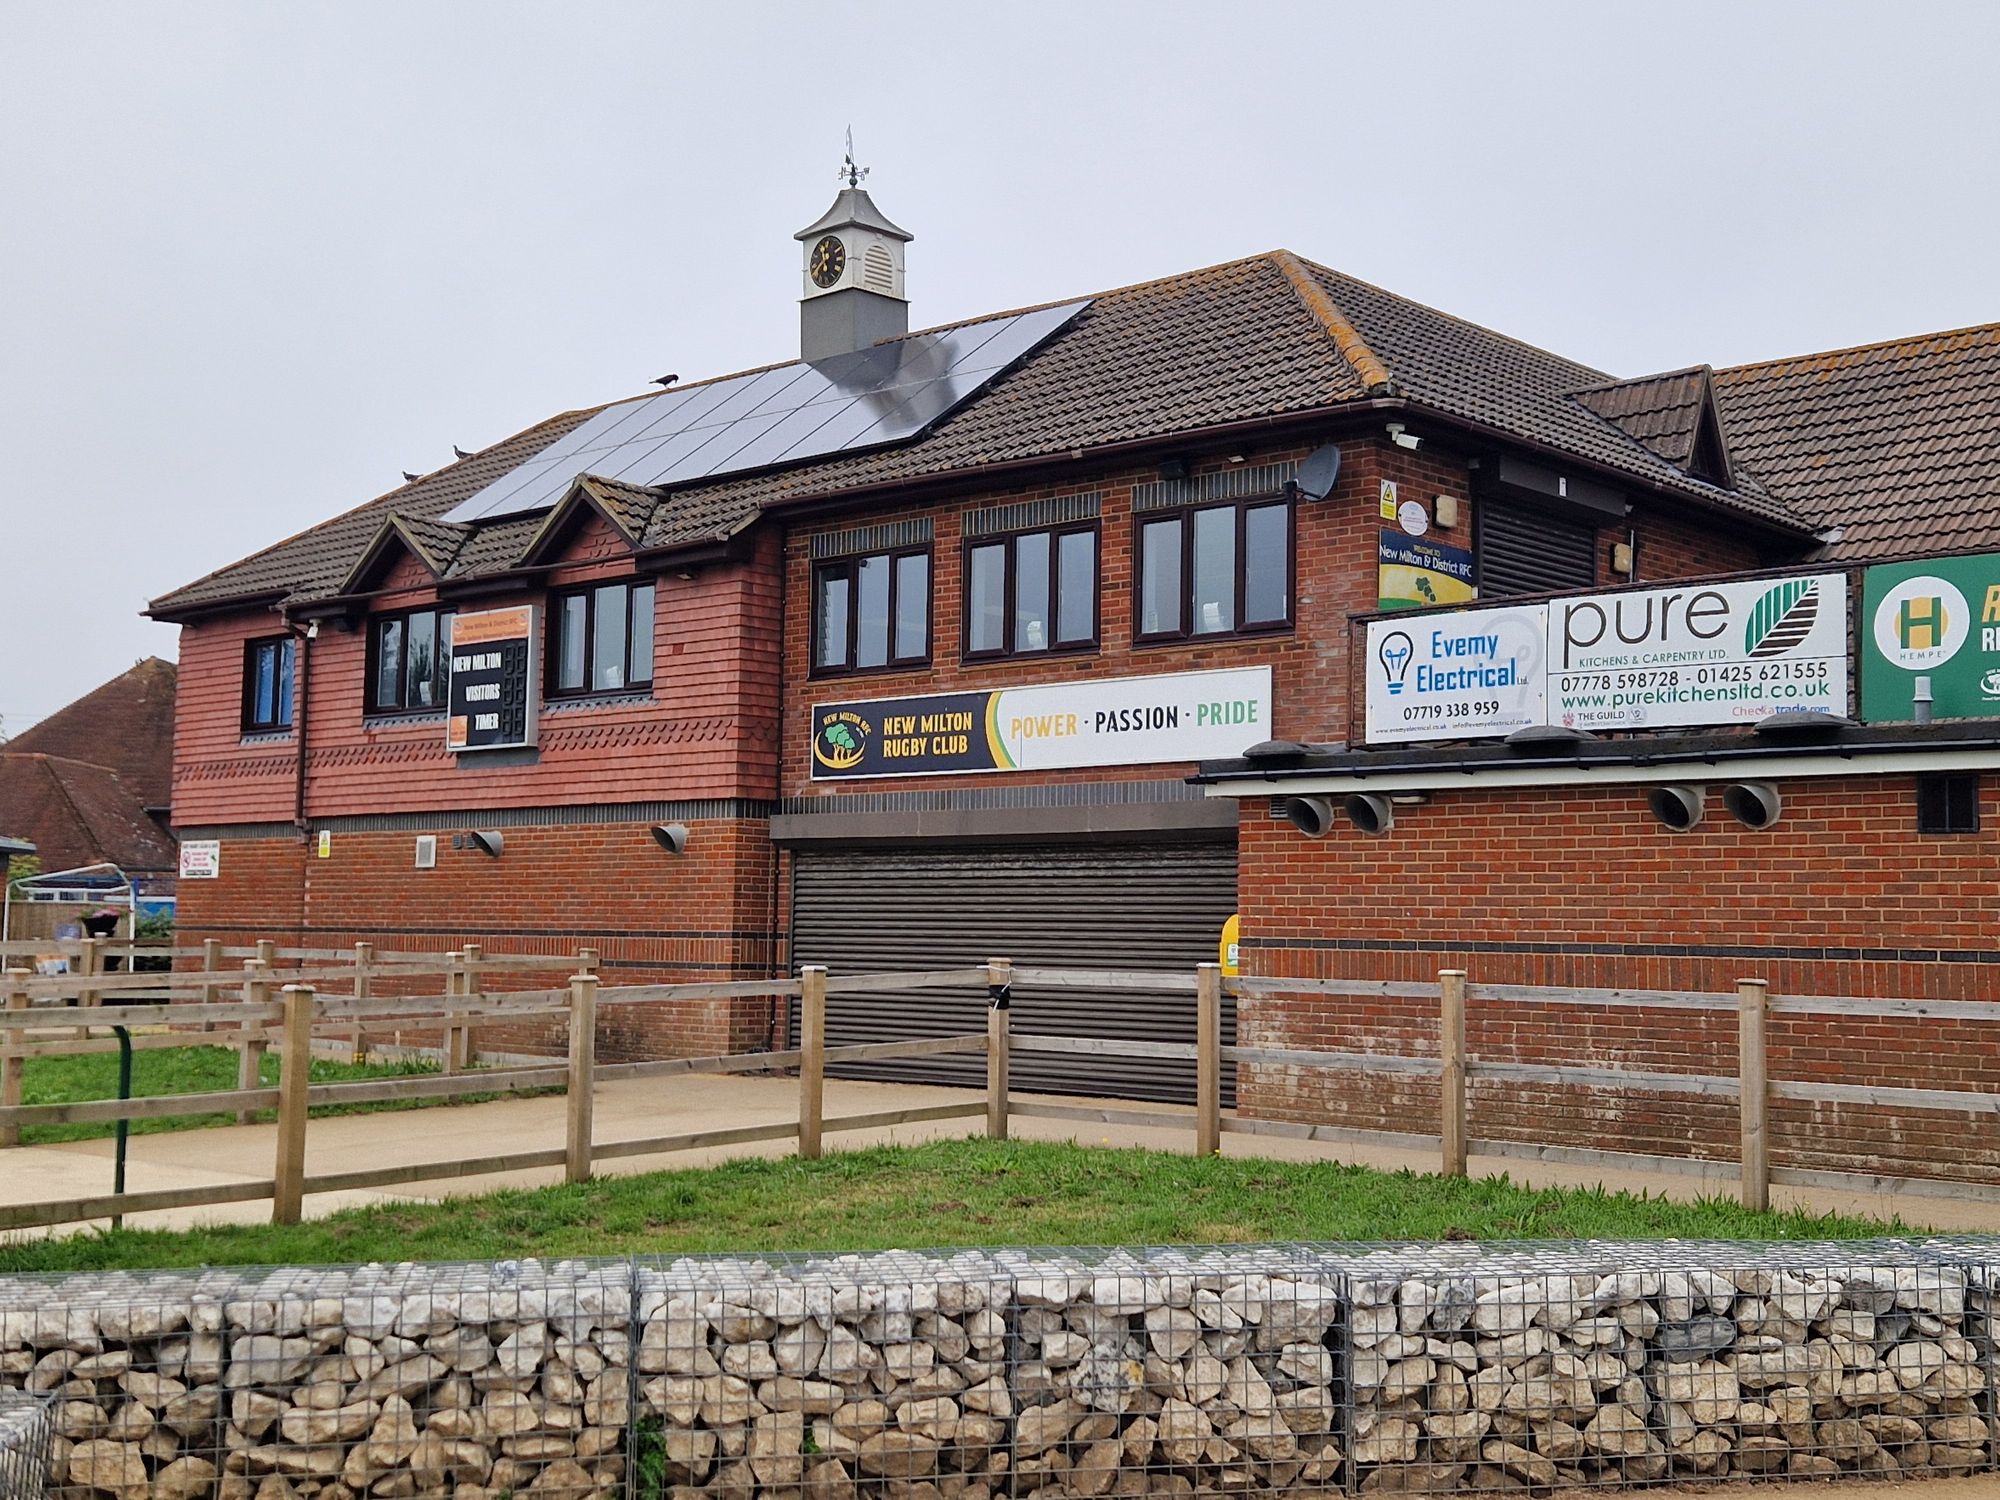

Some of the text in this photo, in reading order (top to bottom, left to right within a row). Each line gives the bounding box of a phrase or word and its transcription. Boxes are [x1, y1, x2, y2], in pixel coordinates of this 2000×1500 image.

[1380, 544, 1472, 577] New Milton & District RFC
[1563, 591, 1730, 669] pure
[1432, 630, 1499, 660] Evemy
[453, 652, 502, 673] NEW MILTON
[1579, 649, 1730, 668] KITCHENS & CARPENTRY LTD.
[1417, 657, 1517, 692] Electrical
[1561, 675, 1611, 692] 07778
[1617, 671, 1679, 689] 598728
[1697, 666, 1752, 684] 01425
[1759, 662, 1827, 681] 621555
[466, 683, 500, 702] VISITORS
[1561, 679, 1830, 709] www.purekitchensltd.co.uk
[475, 713, 499, 730] TIMER
[823, 712, 838, 726] NEW
[839, 711, 861, 725] MILTON
[1011, 713, 1077, 739] POWER
[1095, 705, 1178, 733] PASSION
[1197, 700, 1258, 727] PRIDE
[1404, 701, 1499, 720] 07719 338 959
[1577, 712, 1594, 721] THE
[1597, 711, 1625, 720] GUILD
[1732, 704, 1830, 716] Checkatradecom
[883, 716, 916, 736] NEW
[921, 712, 973, 733] MILTON
[883, 735, 968, 758] RUGBY CLUB
